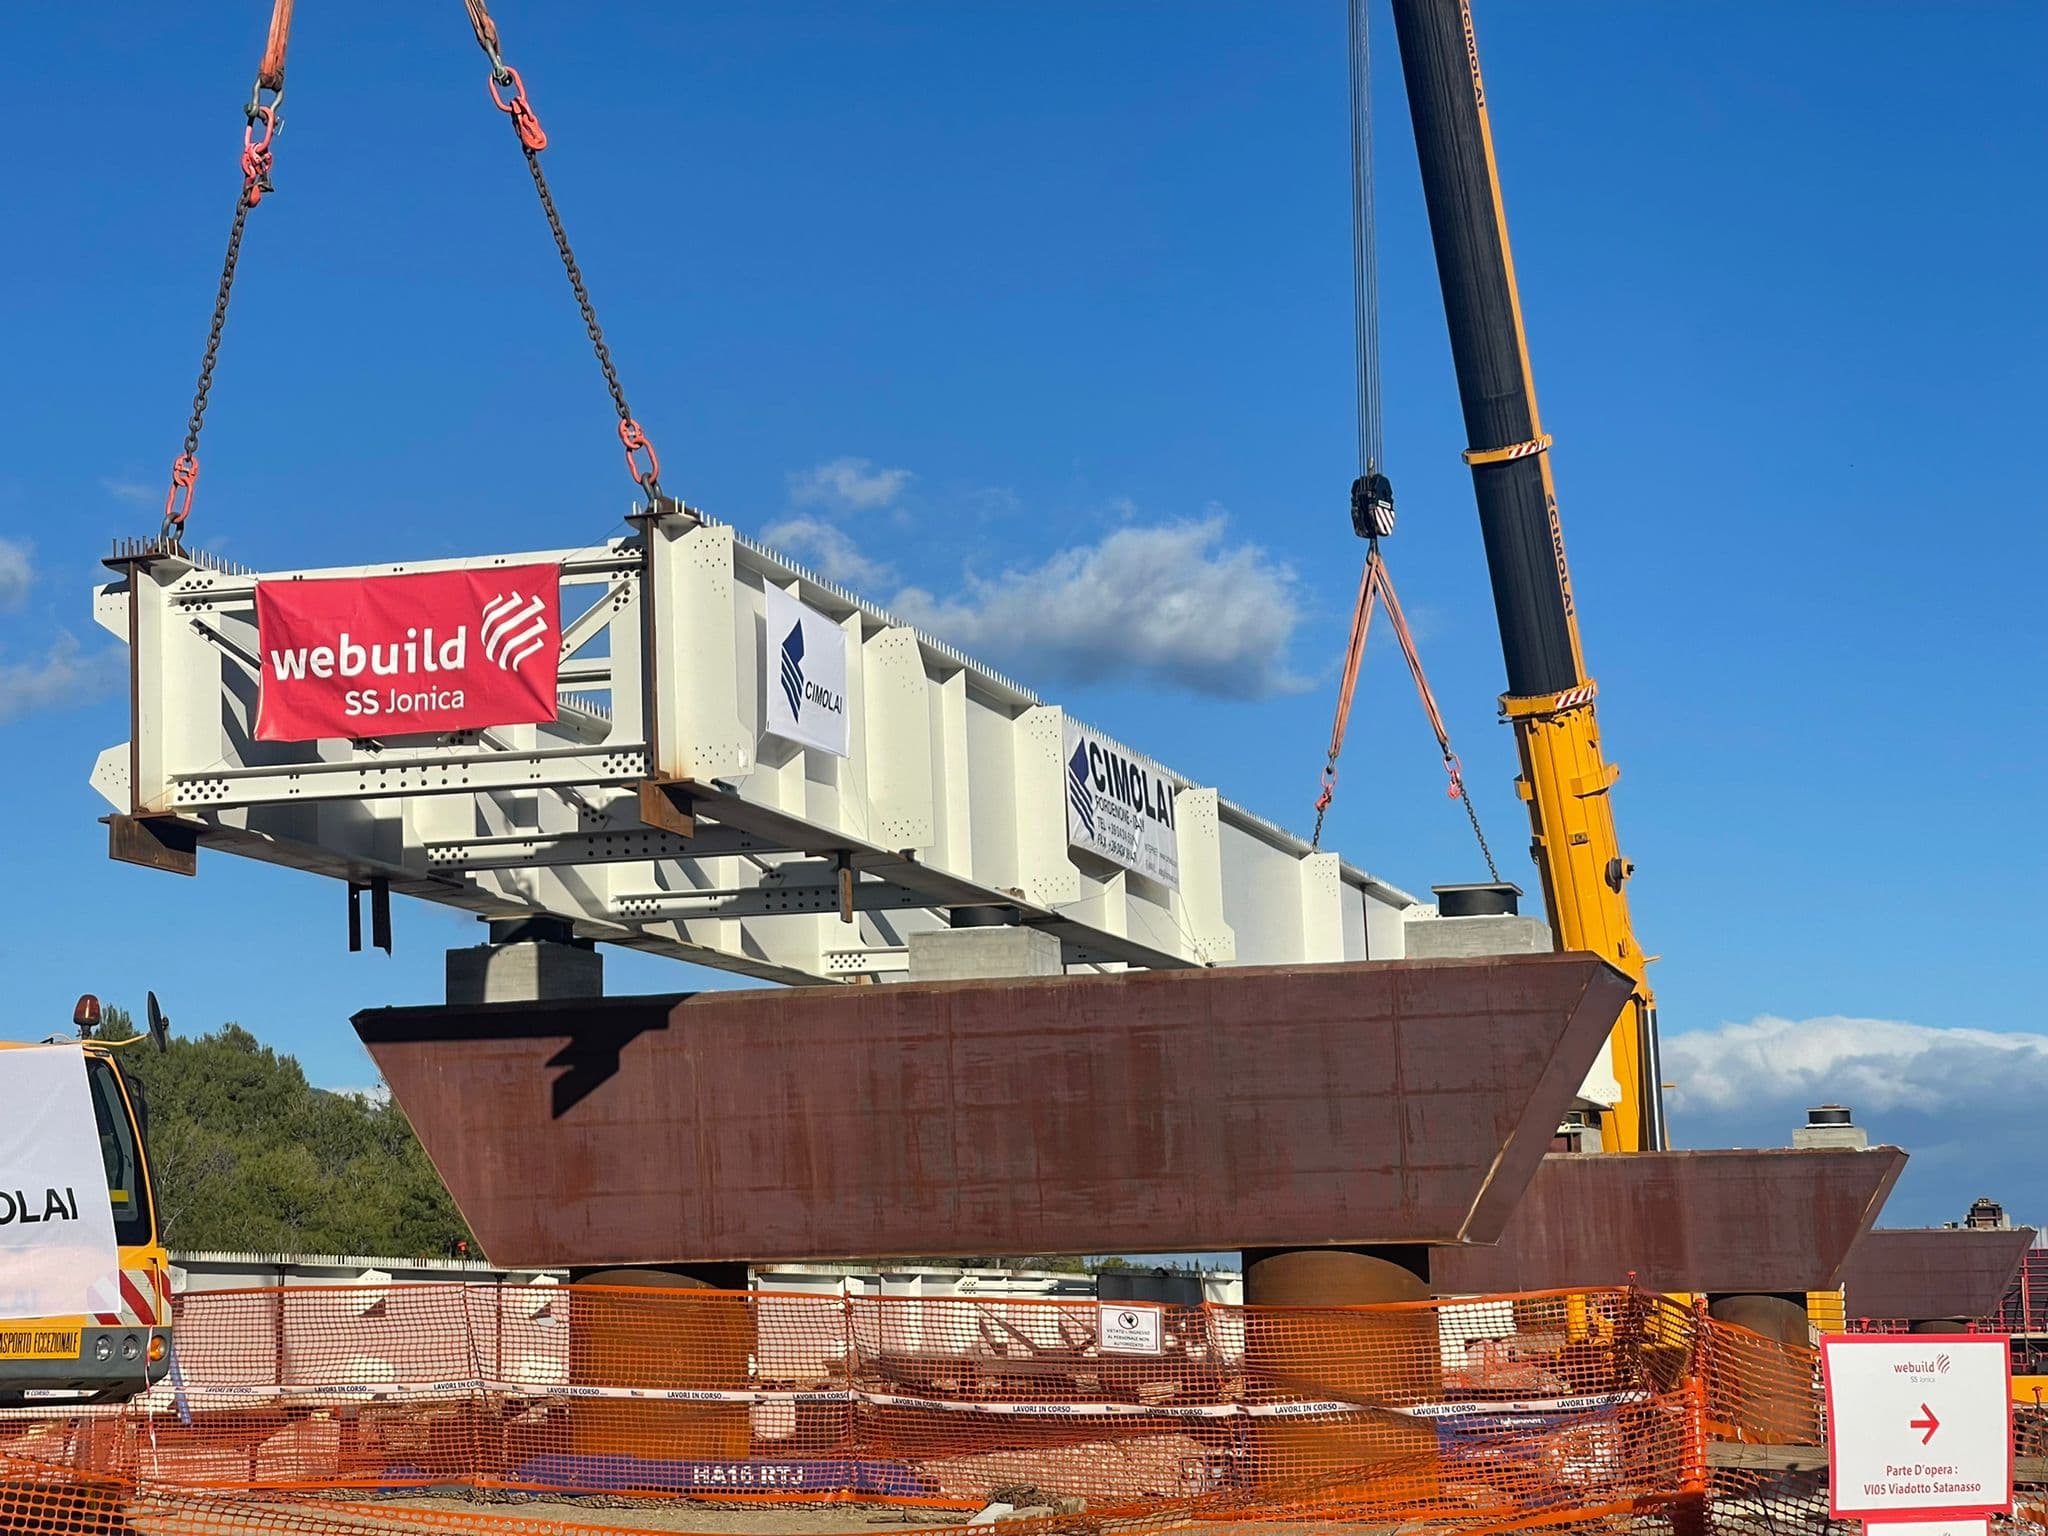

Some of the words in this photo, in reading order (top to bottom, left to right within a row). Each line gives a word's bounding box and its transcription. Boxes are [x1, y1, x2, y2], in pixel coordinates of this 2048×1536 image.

[1463, 12, 1484, 108] CIMOLAI
[1549, 509, 1574, 617] CIMOLAI
[270, 625, 467, 680] webuild
[344, 689, 379, 716] SS
[385, 685, 465, 714] Jonica
[805, 681, 843, 715] CIMOLAI
[1089, 741, 1175, 831] CIMOLAI
[34, 1332, 78, 1353] ECCEZIONALE
[1893, 1361, 1935, 1373] webuild
[579, 1388, 600, 1396] CORSO
[700, 1392, 722, 1400] CORSO
[826, 1392, 849, 1400] CORSO
[1275, 1406, 1301, 1414] LAVORI
[1313, 1403, 1337, 1411] CORSO
[1556, 1400, 1583, 1408] LAVORI
[1596, 1395, 1621, 1404] CORSO
[1012, 1405, 1037, 1413] LAVORI
[1047, 1405, 1071, 1413] CORSO
[1412, 1407, 1439, 1415] LAVORI
[1451, 1404, 1476, 1413] CORSO
[761, 1465, 803, 1485] RTJ
[1886, 1465, 1912, 1476] Parte
[1914, 1464, 1952, 1478] D'opera
[1864, 1484, 1886, 1496] VI05
[1888, 1483, 1931, 1494] Viadotto
[1933, 1482, 1981, 1493] Satanasso
